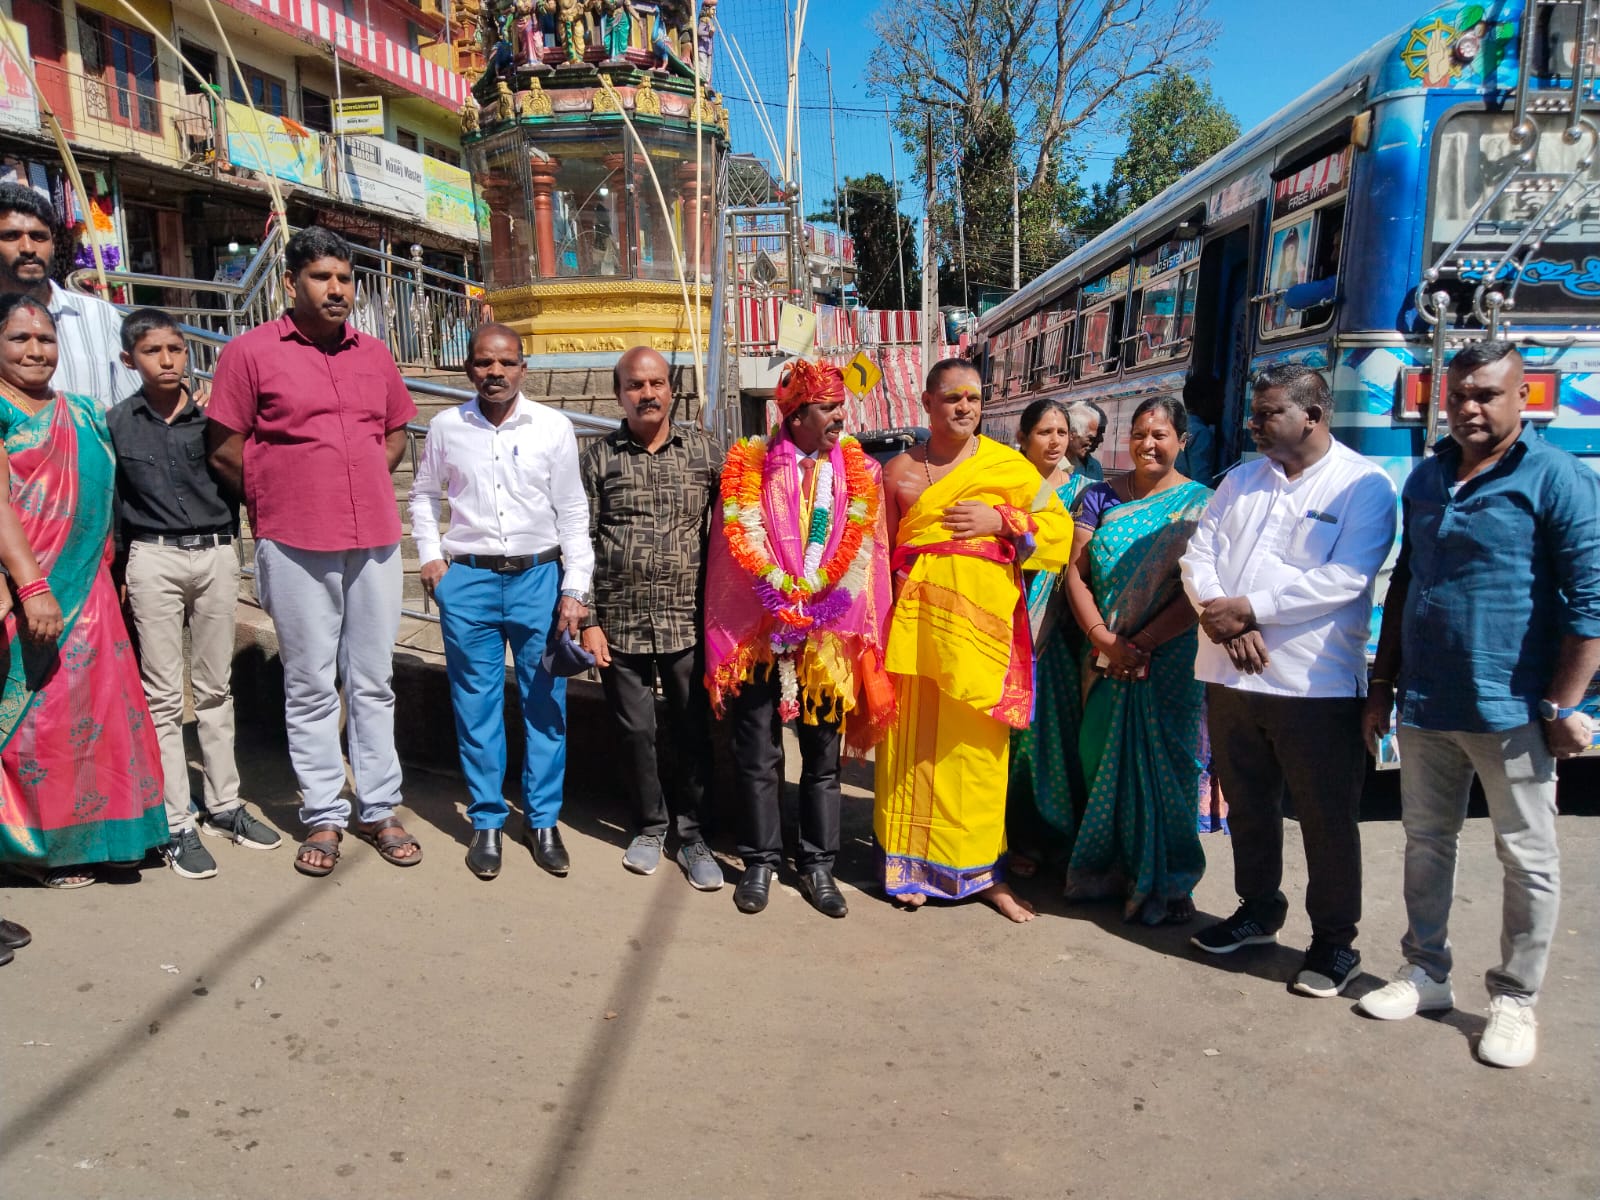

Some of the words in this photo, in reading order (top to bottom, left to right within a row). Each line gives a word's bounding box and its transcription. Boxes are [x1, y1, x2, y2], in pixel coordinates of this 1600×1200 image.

[385, 158, 403, 177] Money
[404, 166, 422, 183] Master
[1288, 191, 1308, 210] FREE
